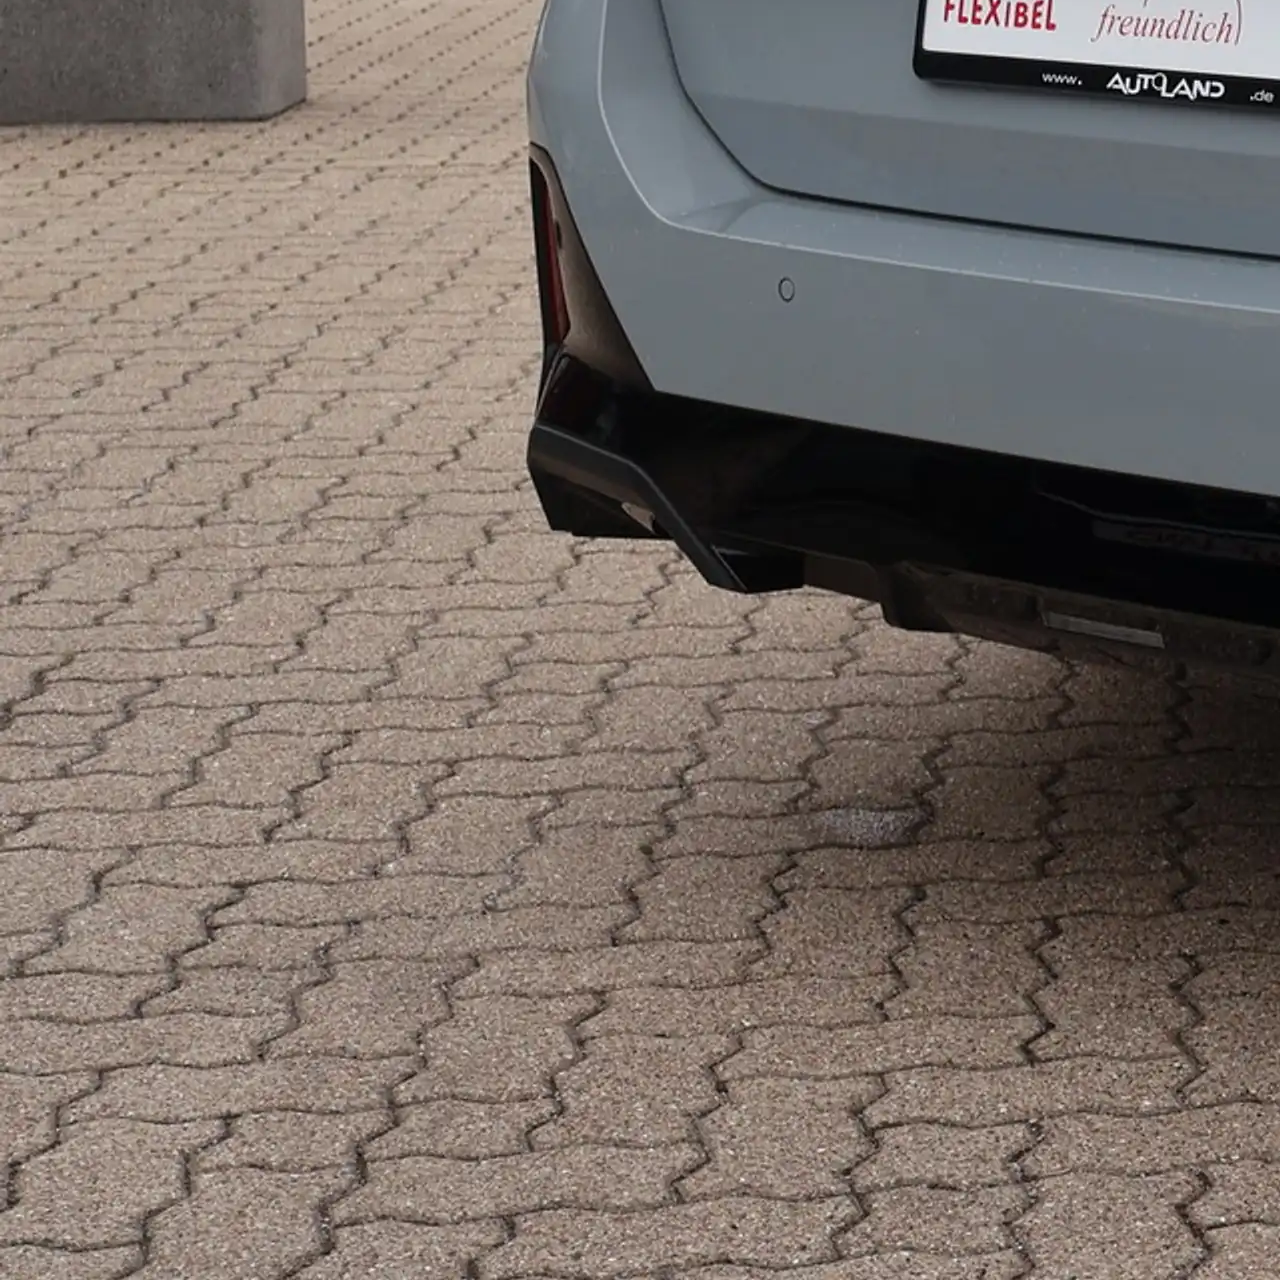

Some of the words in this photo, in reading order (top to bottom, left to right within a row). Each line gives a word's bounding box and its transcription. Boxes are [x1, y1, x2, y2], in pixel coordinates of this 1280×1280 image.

[1091, 5, 1234, 45] freundlich
[1041, 72, 1083, 86] www.
[1106, 72, 1226, 101] AUTOLAND
